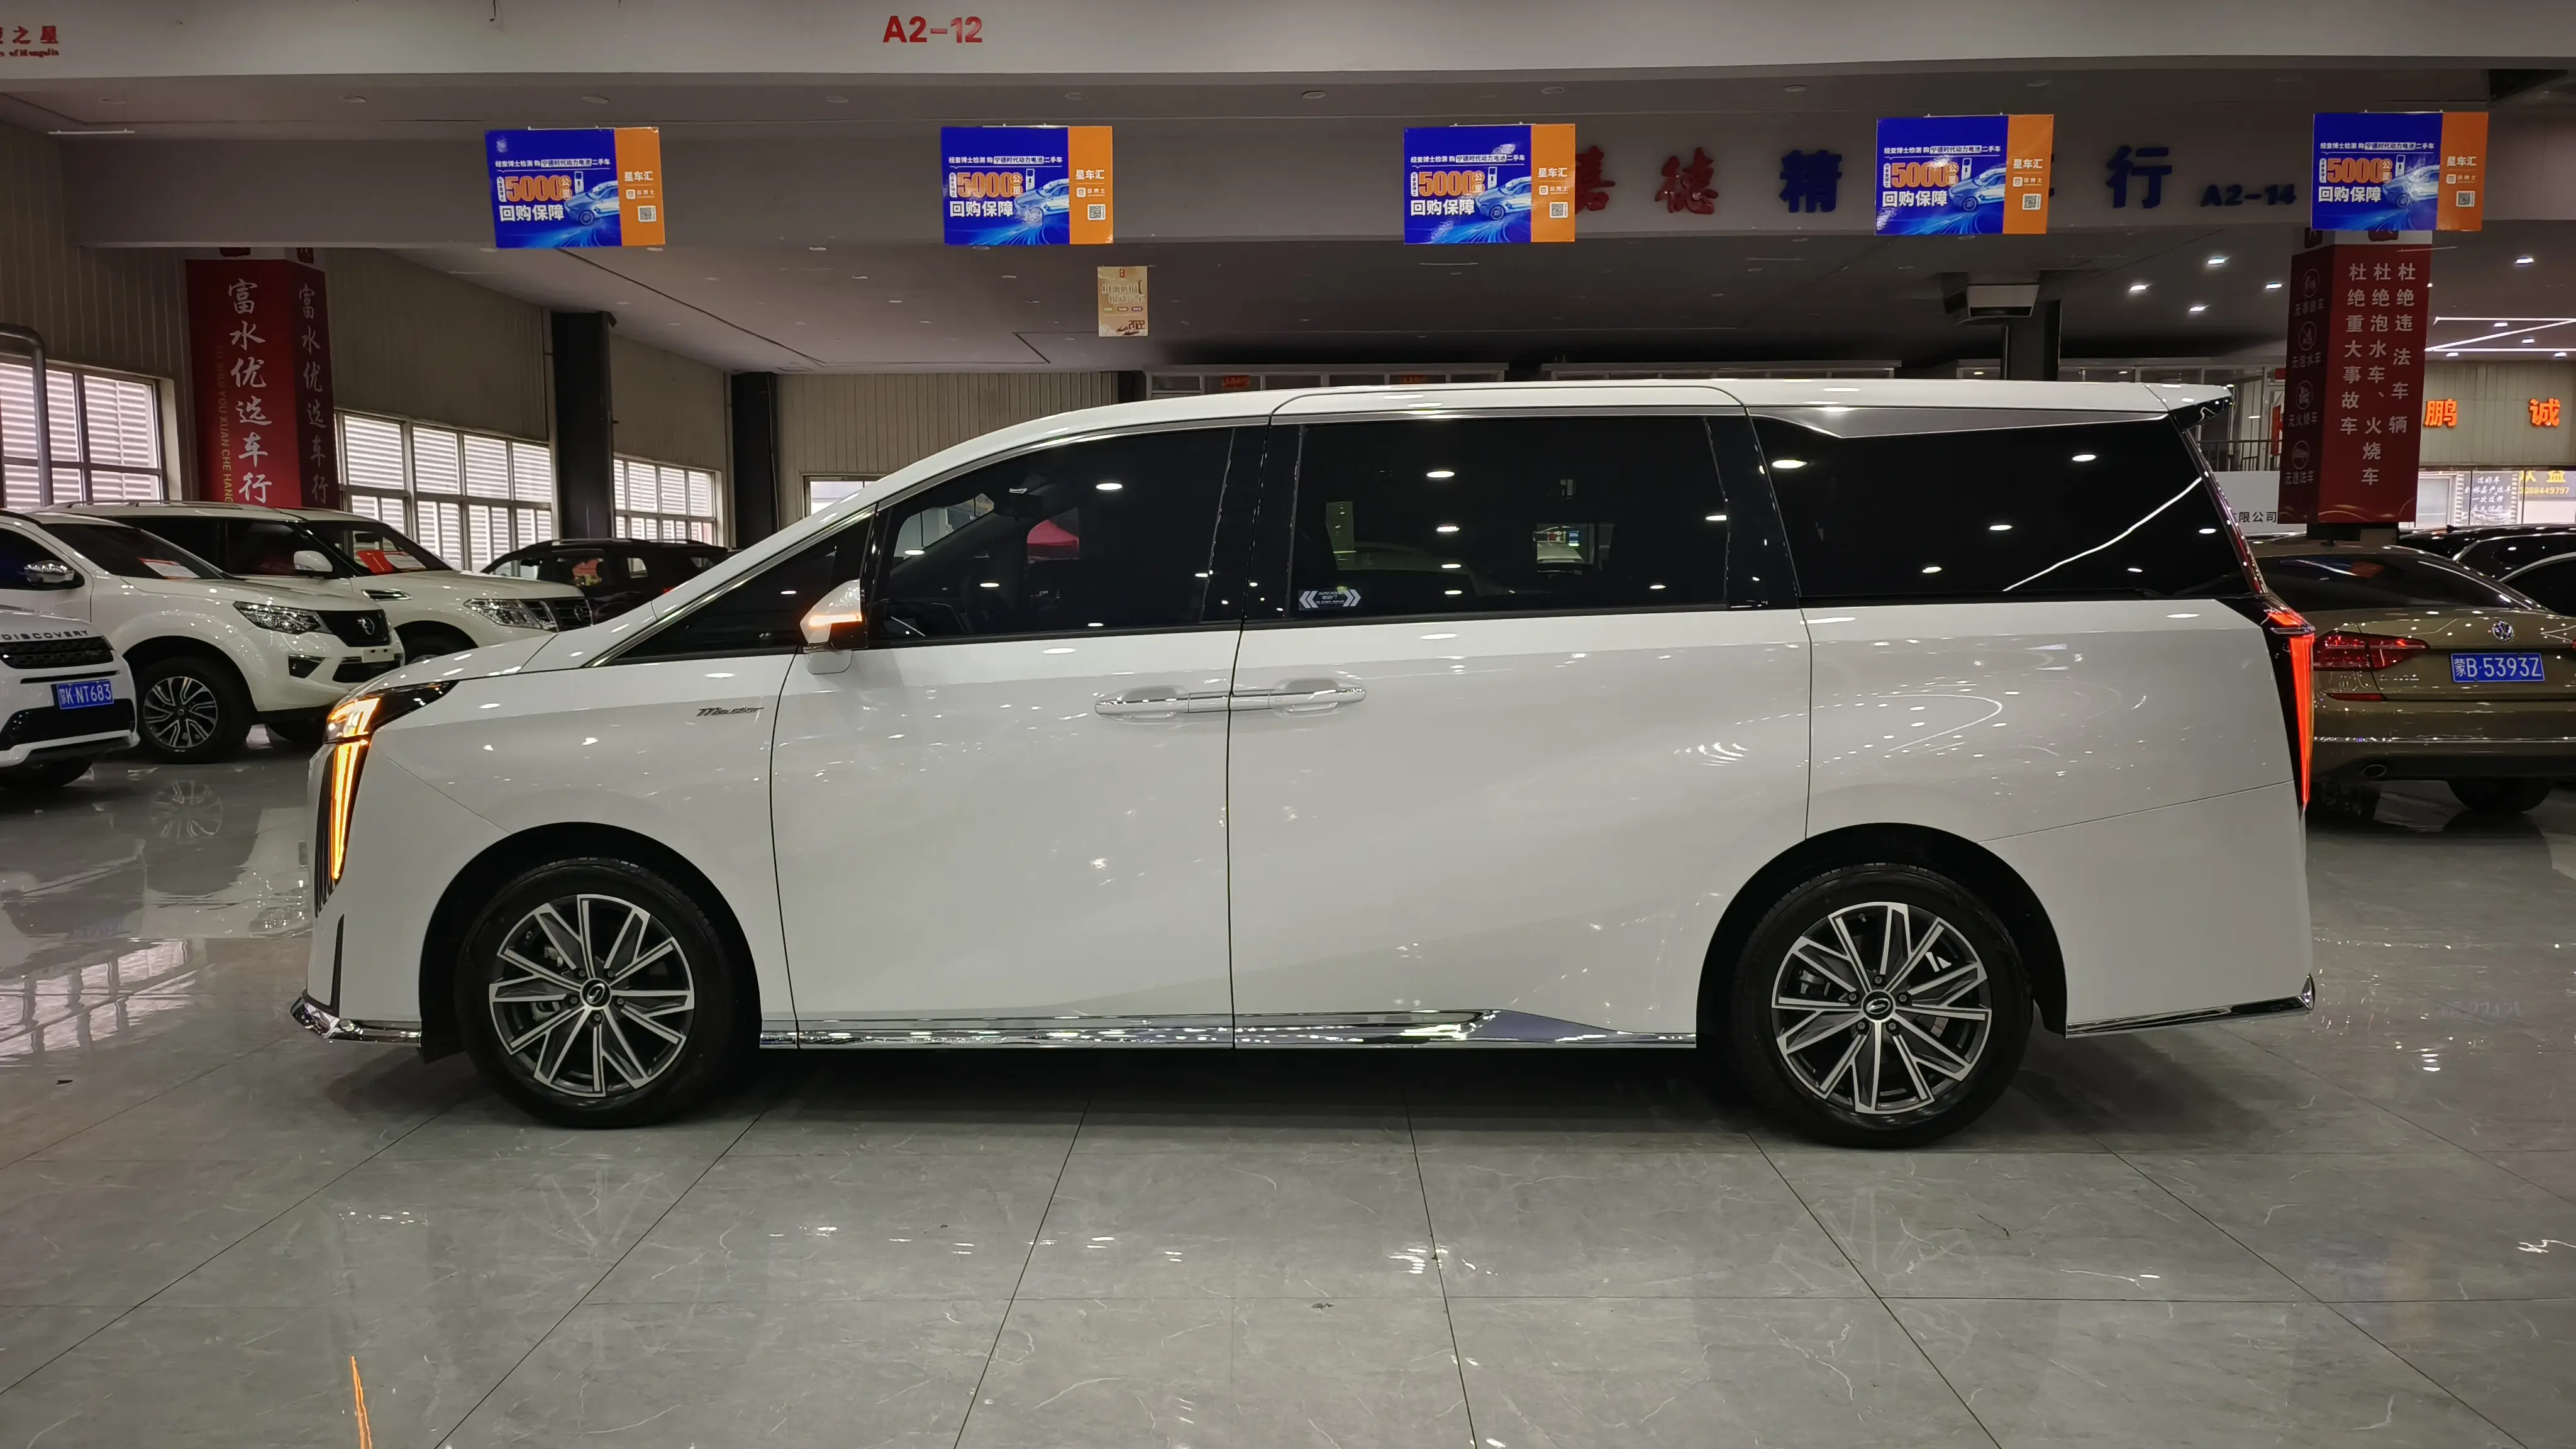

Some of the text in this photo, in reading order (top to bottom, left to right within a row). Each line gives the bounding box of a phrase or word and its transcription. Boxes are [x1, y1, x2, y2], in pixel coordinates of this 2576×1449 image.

[0, 26, 59, 44] 之星
[883, 16, 982, 43] A2-12
[1538, 167, 1568, 178] 星车汇
[2013, 158, 2043, 169] 星车汇
[2327, 158, 2384, 184] 5000
[2446, 156, 2477, 166] 星车汇
[624, 171, 654, 182] 星车汇
[957, 172, 1012, 197] 5000
[1075, 169, 1105, 180] 星车汇
[1418, 170, 1475, 197] 5000
[1779, 150, 1842, 213] 精
[2106, 145, 2172, 208] 行
[2201, 184, 2297, 207] A2-14
[1892, 162, 1948, 188] 5000
[505, 175, 562, 202] 5000
[1882, 191, 1948, 208] 回购保障
[2318, 186, 2382, 203] 回购保障
[499, 204, 565, 222] 回购保障
[950, 201, 1014, 218] 回购保障
[1411, 199, 1475, 216] 回购保障
[2340, 263, 2367, 435] 杜绝重大事故车
[2389, 262, 2416, 434] 杜绝违法车辆
[217, 390, 228, 413] YOU
[228, 278, 272, 504] 富水优选车行
[299, 284, 329, 504] 富水优选车行
[2424, 398, 2560, 427] 鹏 诚
[219, 416, 230, 447] XUAN
[222, 449, 231, 470] CHE
[223, 474, 233, 503] HANG
[2233, 511, 2277, 523] 限公司
[1, 630, 89, 640] DISCOVERY
